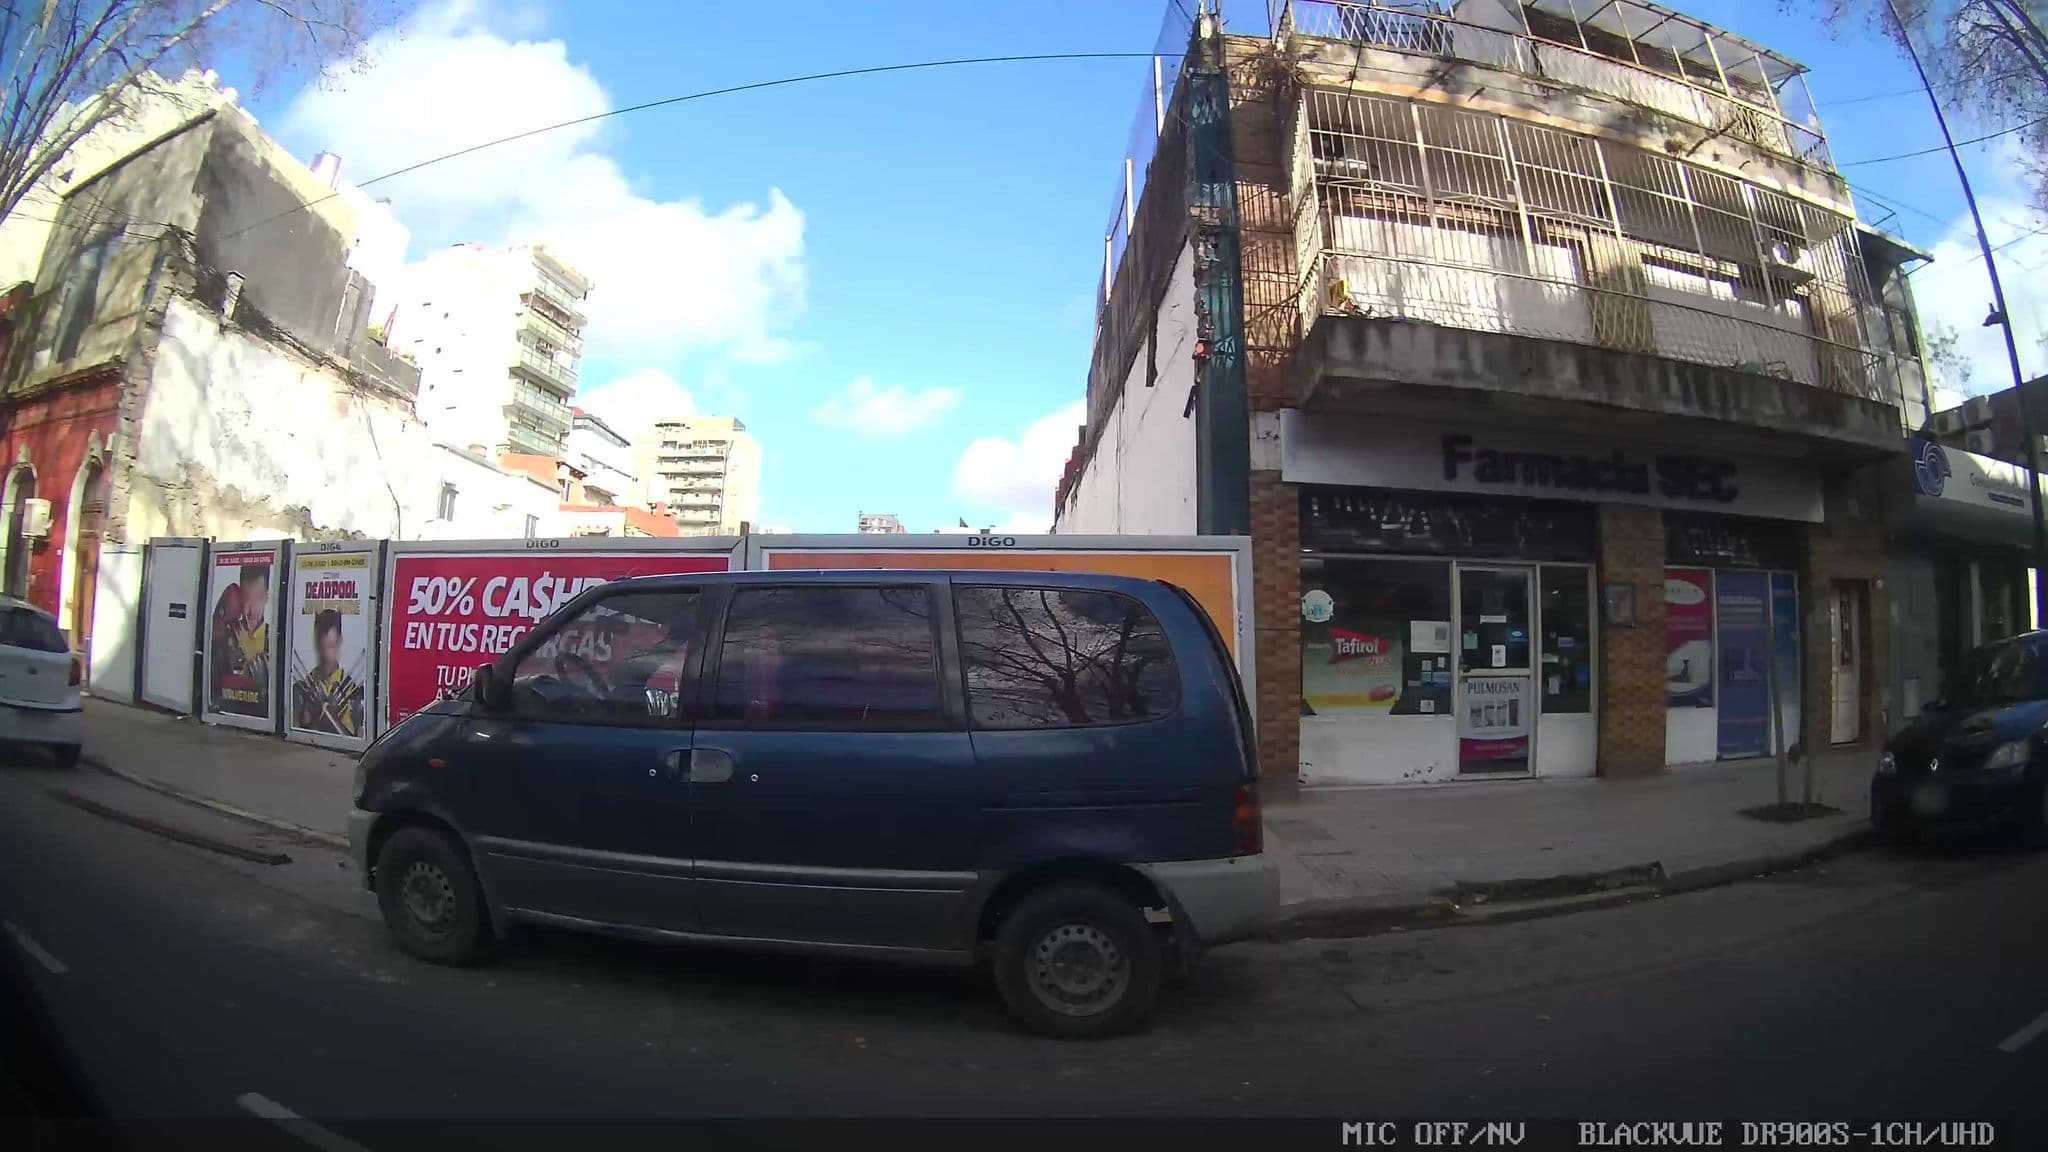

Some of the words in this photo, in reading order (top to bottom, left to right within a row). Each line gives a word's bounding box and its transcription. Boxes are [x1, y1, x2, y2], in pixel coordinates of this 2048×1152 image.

[1442, 433, 1649, 494] Farmacia
[305, 580, 359, 599] DEADPOOL
[407, 576, 478, 616] 50%
[404, 622, 434, 650] EN
[437, 623, 479, 652] TUS
[1335, 638, 1379, 656] Tafirol
[437, 665, 456, 686] TU
